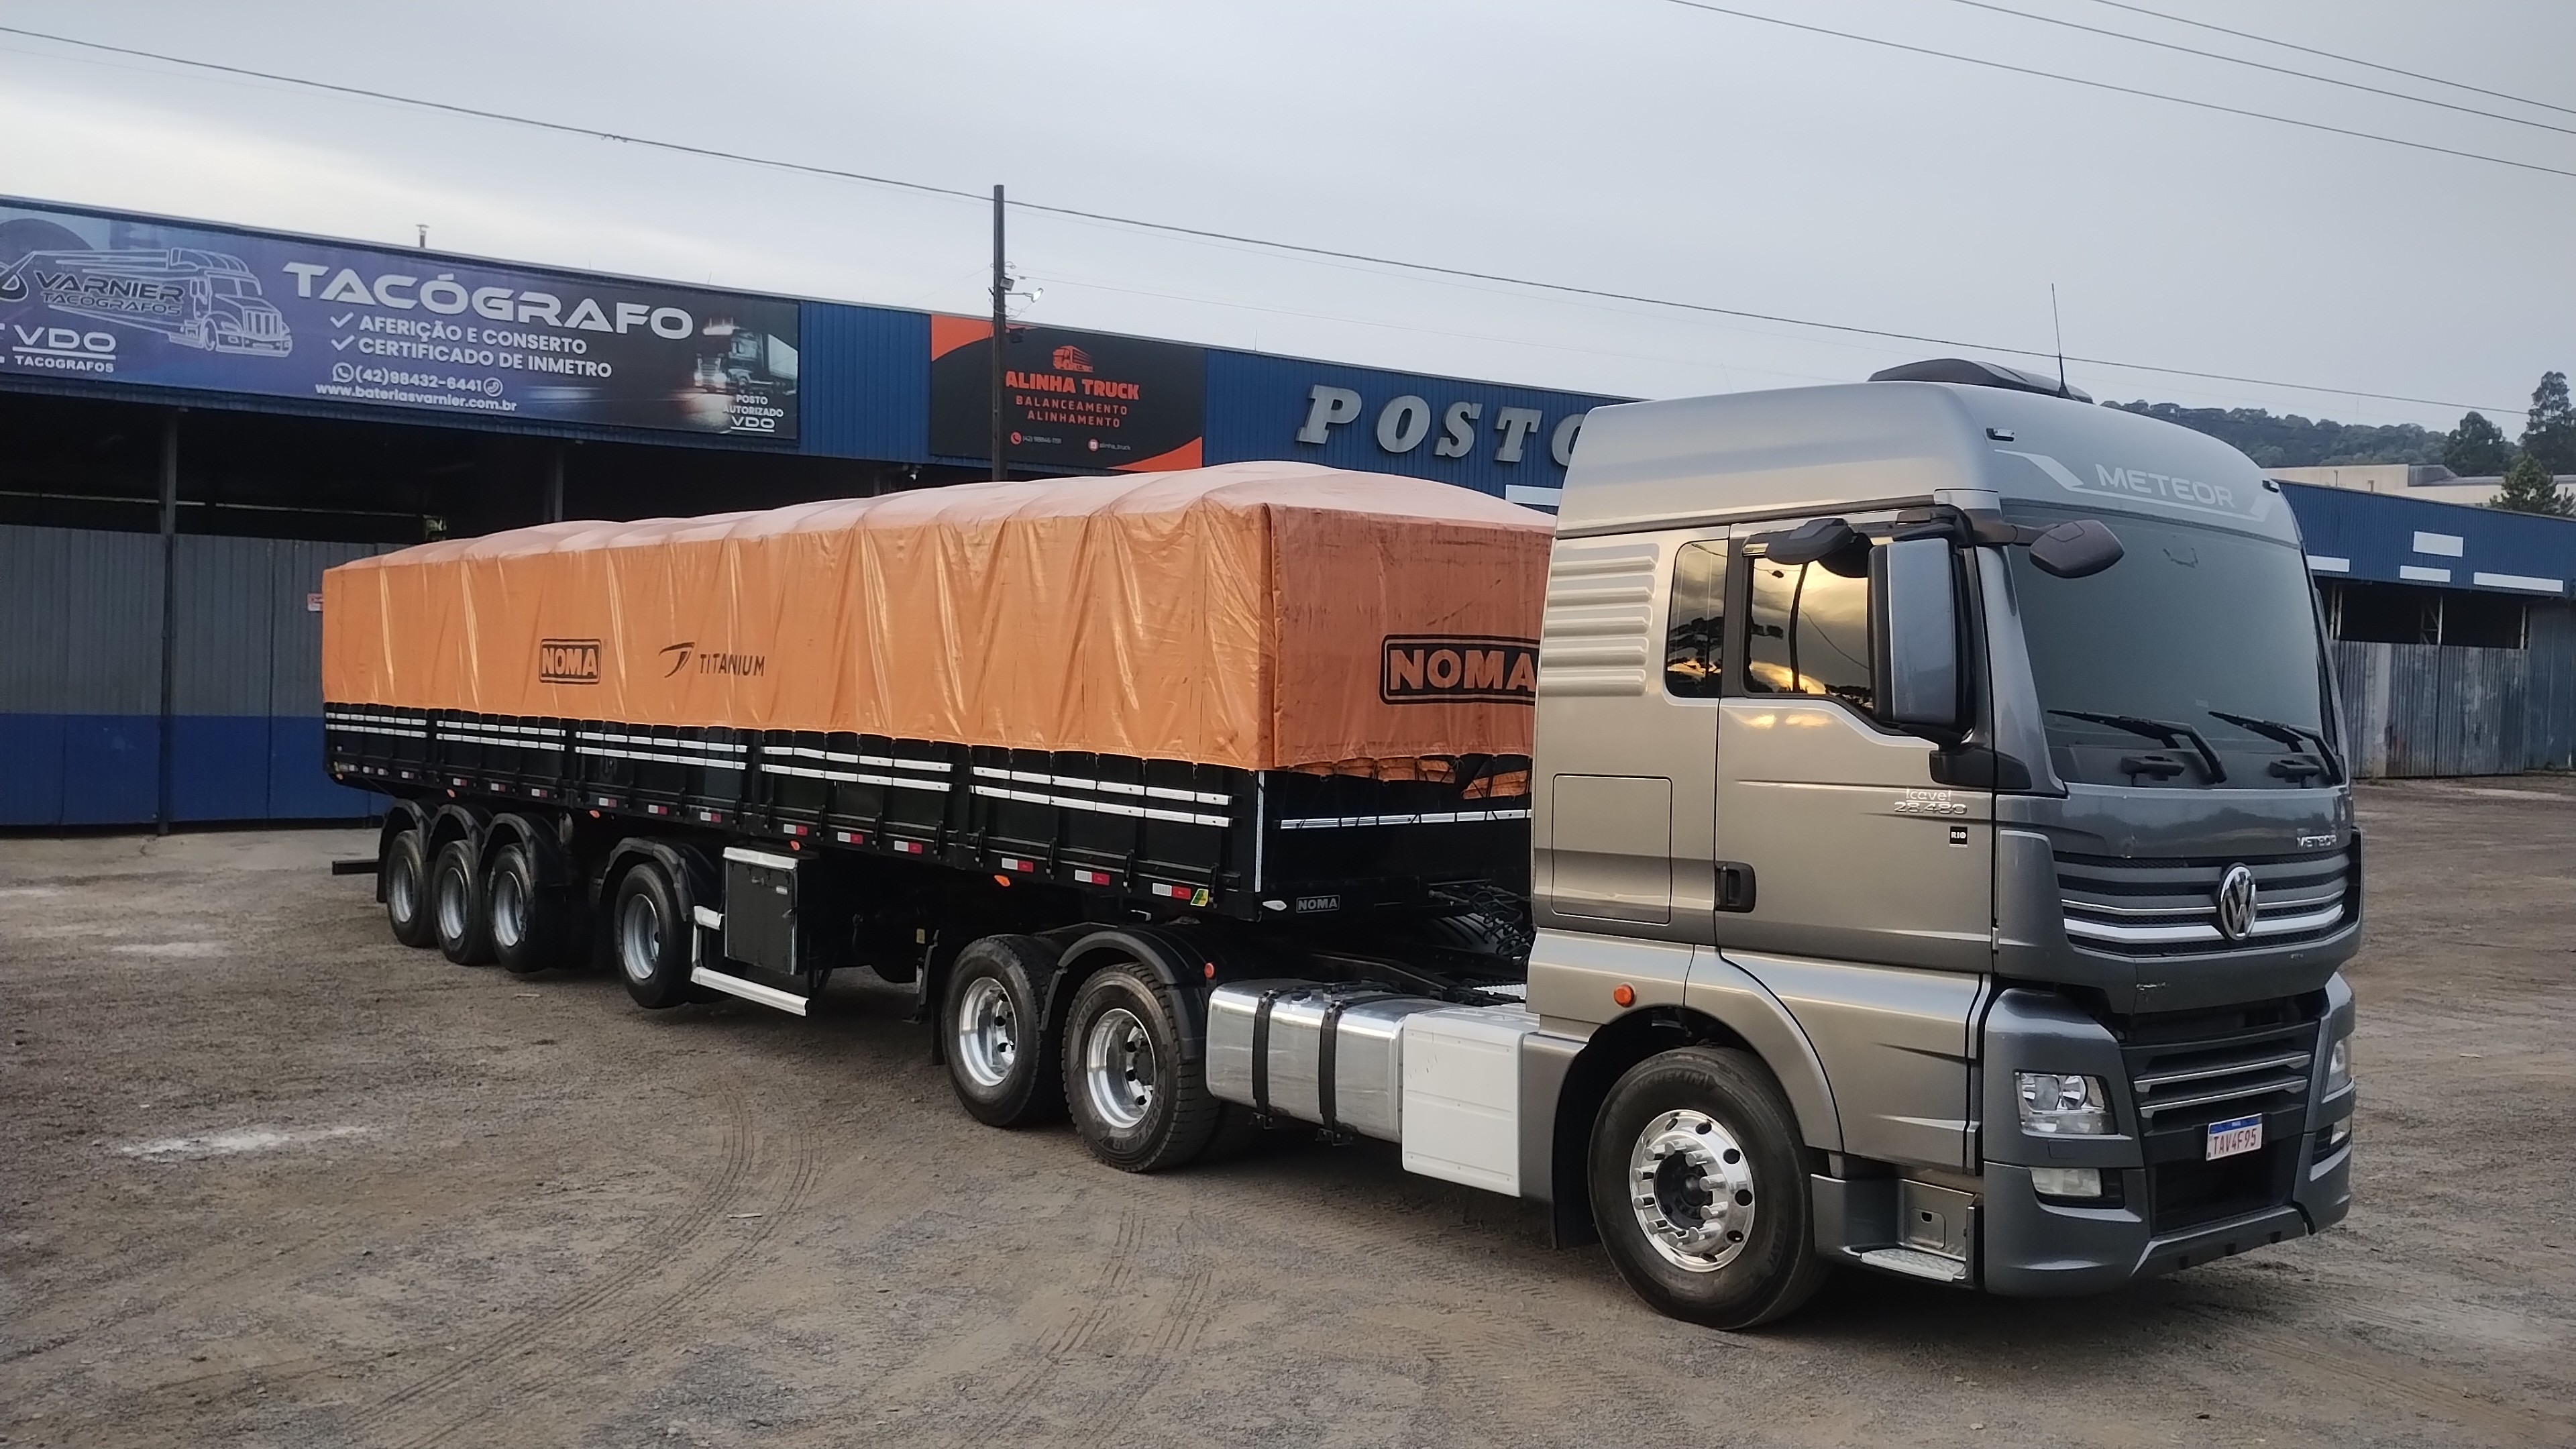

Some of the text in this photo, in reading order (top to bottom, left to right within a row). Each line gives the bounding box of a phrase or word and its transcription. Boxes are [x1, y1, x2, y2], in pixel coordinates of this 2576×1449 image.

[34, 270, 184, 302] VARNIER
[42, 292, 182, 315] TACOGRAFOS
[282, 262, 694, 339] TACÓGRAFO
[13, 325, 116, 352] VDO
[359, 315, 587, 354] AFERIÇÃO E CONSERTO
[15, 356, 114, 373] TACOGRAFOS
[359, 337, 612, 377] CERTIFICADO DE INMETRO
[315, 384, 517, 411] www.bateriasvarnier.com.br
[1006, 371, 1139, 400] ALINHA TRUCK
[723, 405, 784, 417] AUTORIZADO
[737, 394, 768, 405] POSTO
[1016, 395, 1128, 415] BALANCEAMENTO
[732, 416, 775, 428] VDO
[1028, 411, 1120, 428] ALINHAMENTO
[2095, 464, 2235, 508] METEOR
[542, 647, 598, 676] NOMA
[700, 653, 765, 677] TITANIUM
[1389, 649, 1536, 693] NOMA
[1298, 897, 1338, 912] NOMA
[2214, 1128, 2257, 1155] TAV4F95
